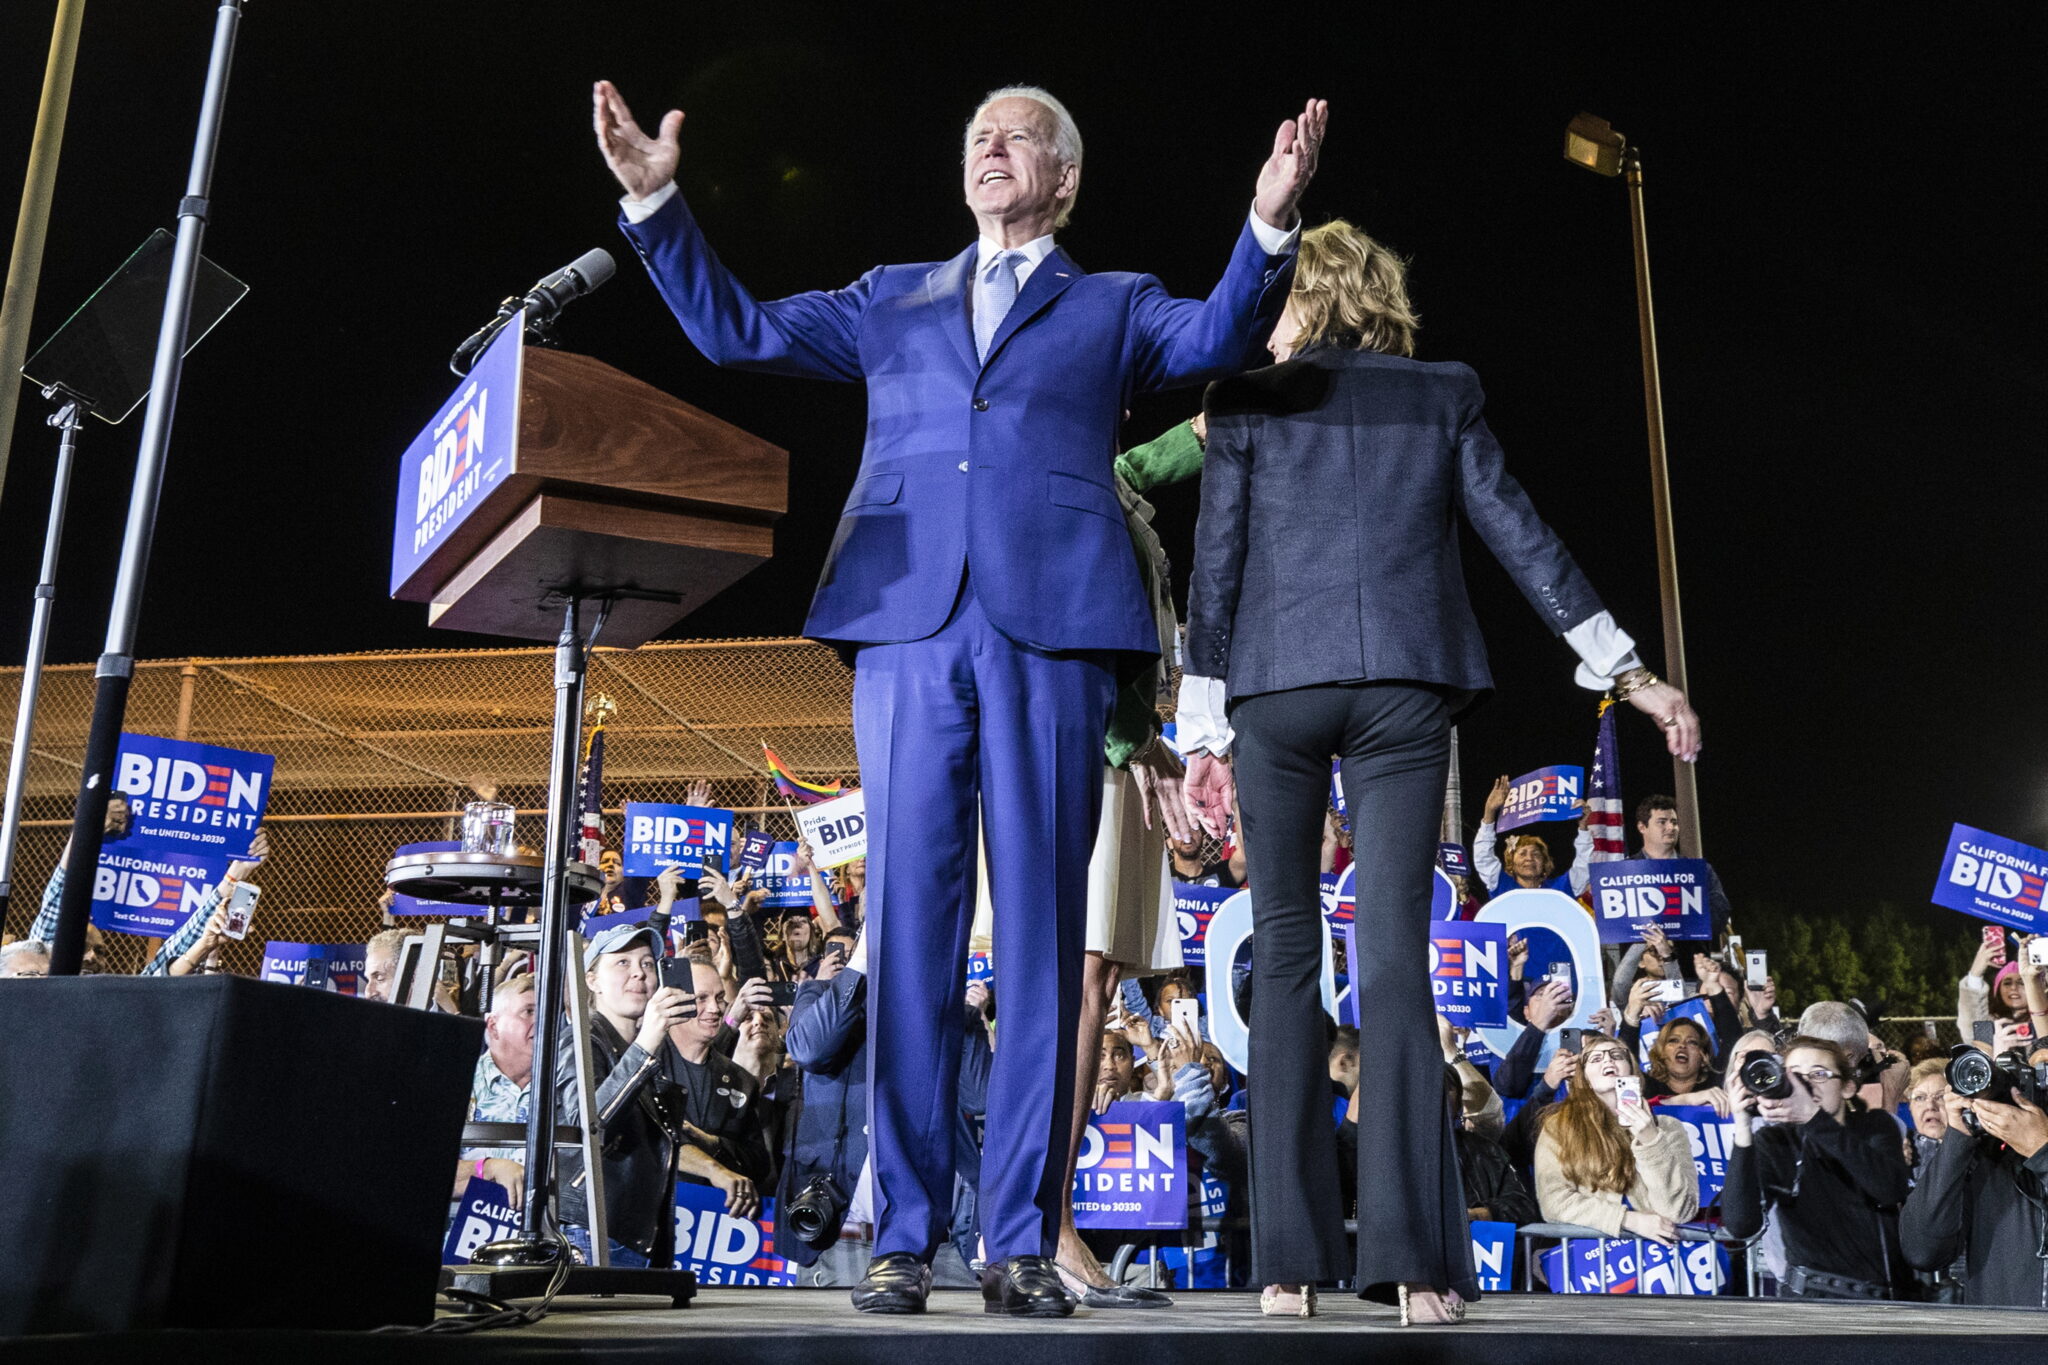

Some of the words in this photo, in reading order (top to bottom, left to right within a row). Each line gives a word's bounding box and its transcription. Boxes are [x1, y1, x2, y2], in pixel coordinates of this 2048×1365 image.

[416, 388, 488, 525] BIDEN
[414, 461, 482, 554] PRESIDENT
[117, 752, 263, 812] BIDEN
[1504, 775, 1578, 808] BIDEN
[131, 799, 257, 830] RESIDENT
[1502, 796, 1577, 816] PRESIDENT
[140, 826, 158, 836] Text
[159, 828, 190, 840] UNITED
[632, 815, 727, 848] BIDEN
[803, 815, 827, 828] Pride
[807, 827, 817, 836] for
[818, 811, 865, 846] BID
[98, 853, 176, 876] CALIFORNIA
[178, 866, 208, 880] FOR
[1959, 841, 2038, 875] CALIFORNIA
[92, 866, 213, 913] BIDEN
[1600, 874, 1673, 887] CALIFORNIA
[1674, 873, 1695, 884] FOR
[1601, 886, 1703, 919] BIDEN
[1990, 902, 2001, 912] CA
[129, 913, 140, 922] CA
[670, 914, 686, 925] OR
[270, 958, 348, 972] CALIFNIA
[1447, 1004, 1471, 1013] 30330
[1076, 1123, 1174, 1170] DEN
[471, 1199, 522, 1226] CALIFO
[1072, 1202, 1099, 1212] NITED
[1100, 1203, 1111, 1212] to
[1112, 1202, 1141, 1212] 30330
